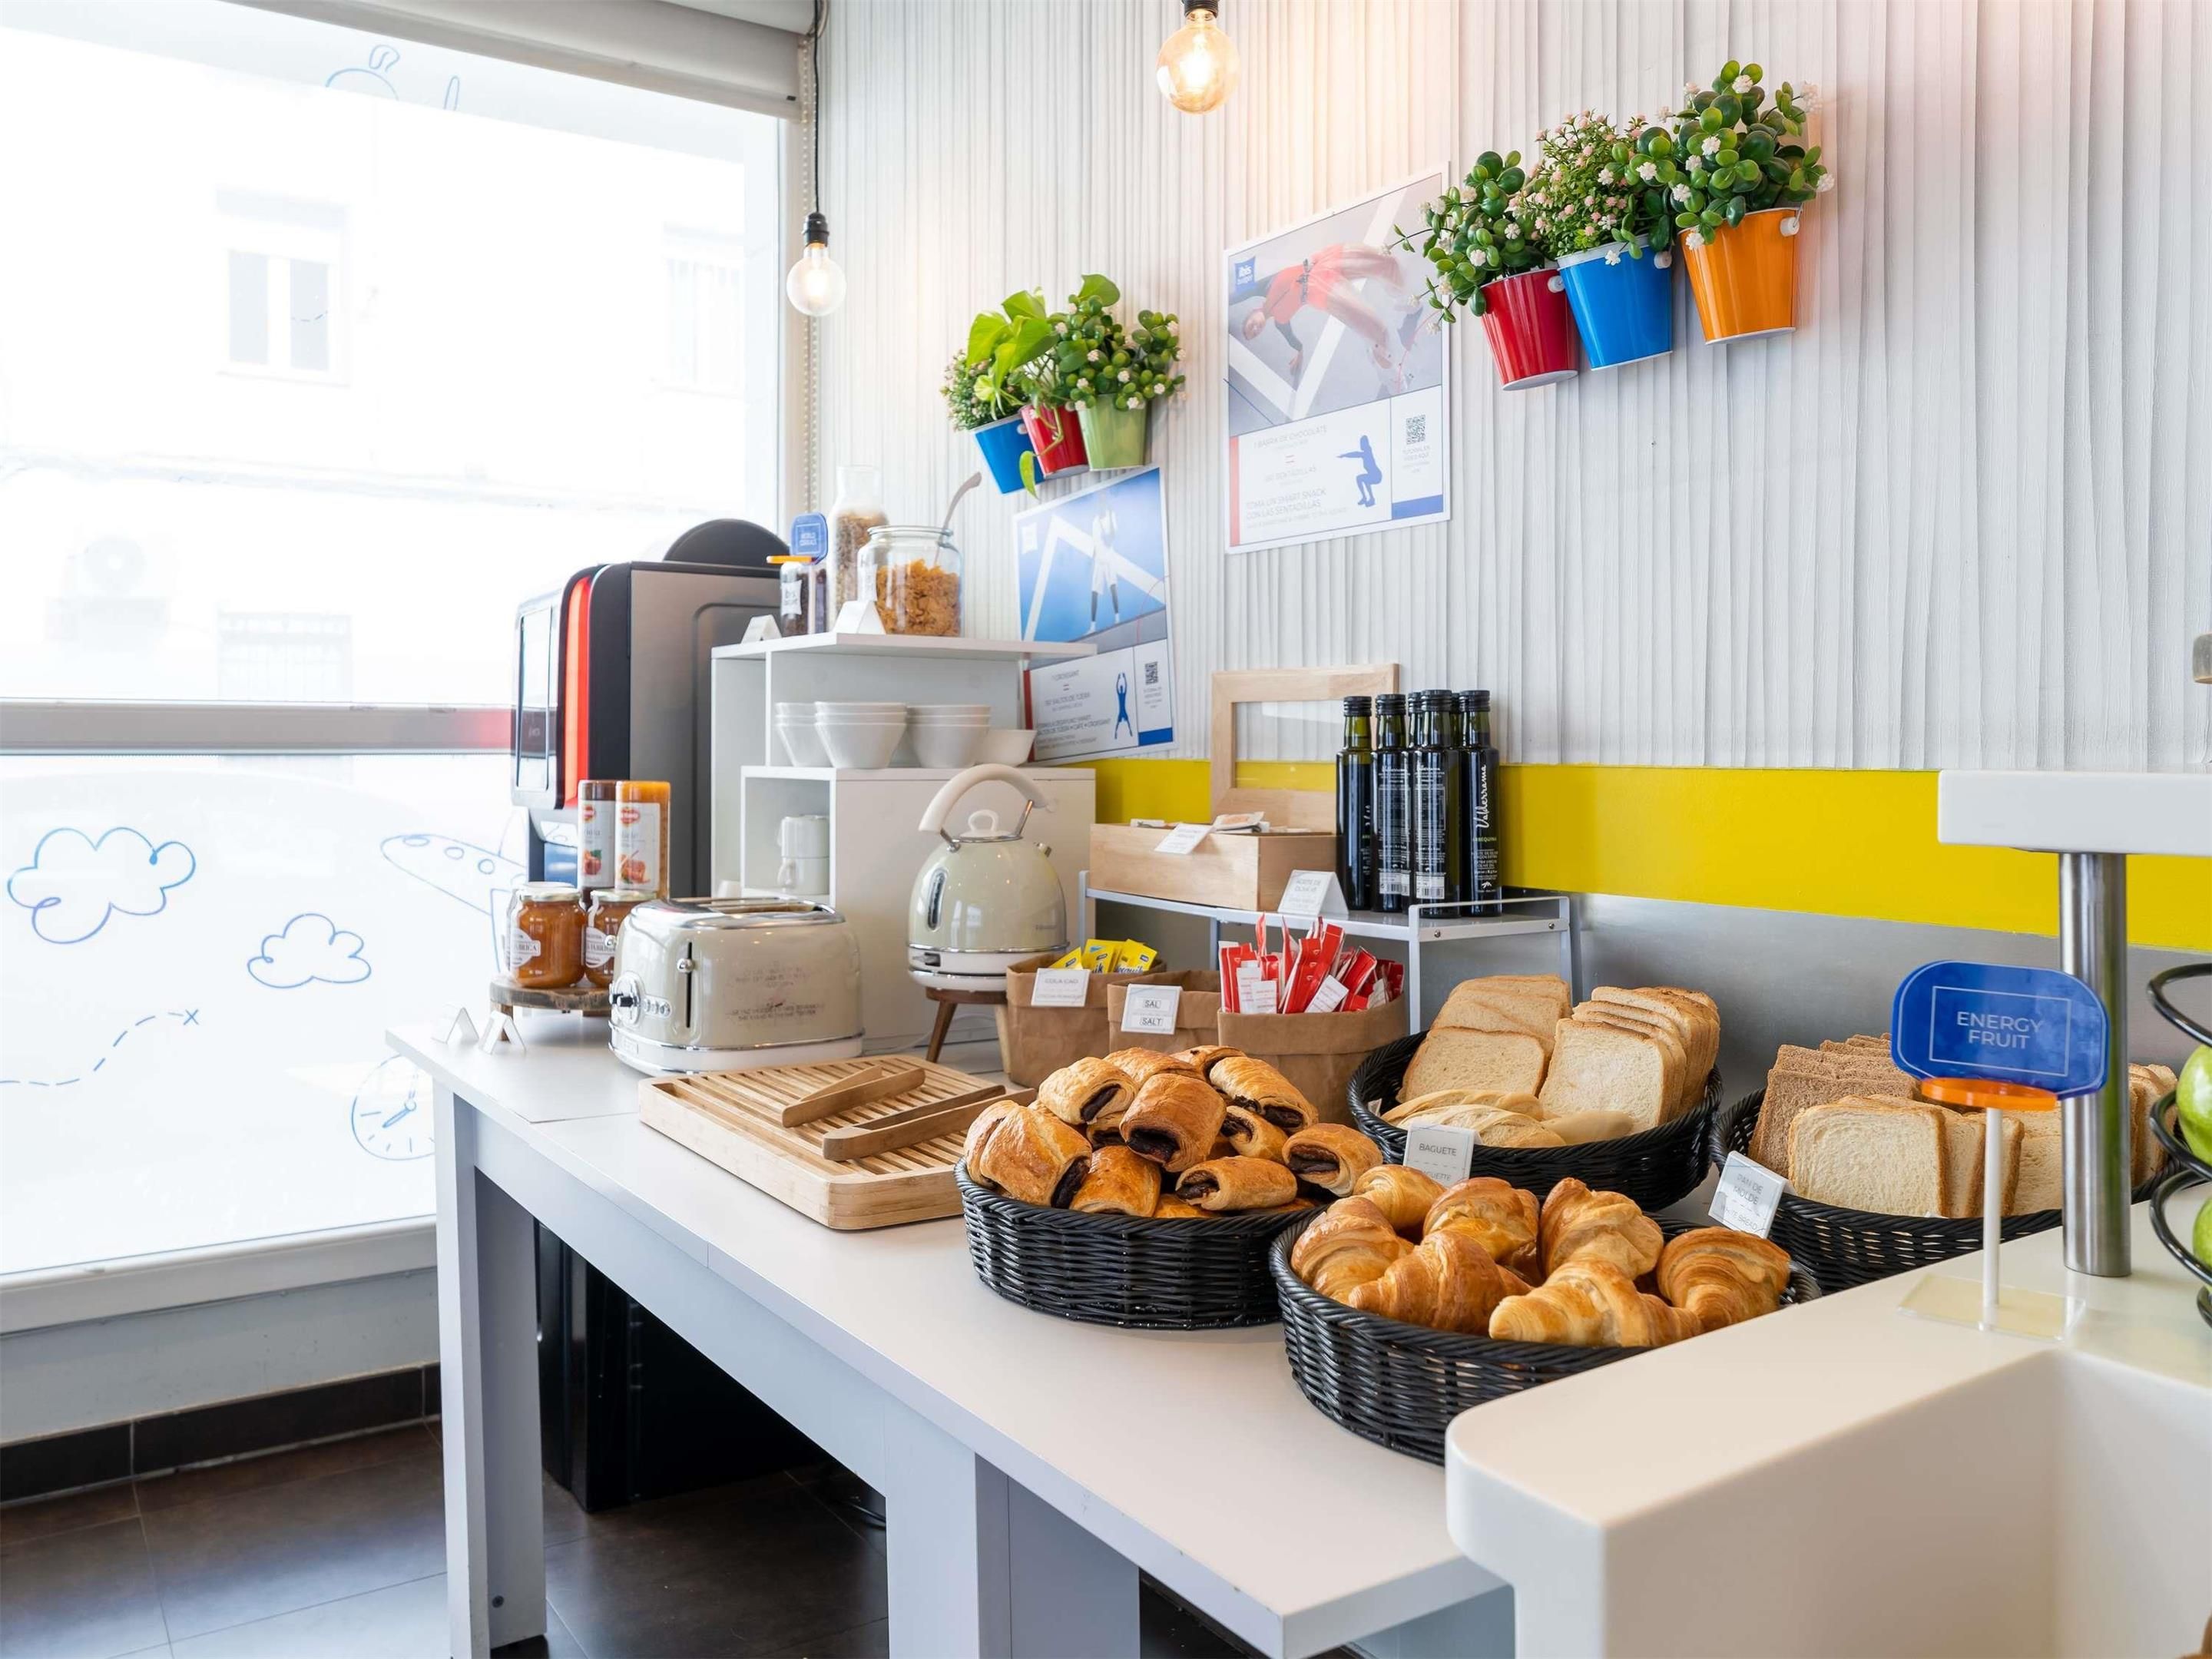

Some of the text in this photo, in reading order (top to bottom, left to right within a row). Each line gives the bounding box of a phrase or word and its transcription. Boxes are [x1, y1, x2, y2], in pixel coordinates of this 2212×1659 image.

[1290, 424, 1327, 440] CHOCOLATE
[1302, 487, 1326, 498] SNACK
[1275, 498, 1322, 514] SENTADILLAS
[1473, 764, 1490, 830] Valderrama
[1144, 1000, 1161, 1008] SAL
[1141, 1018, 1162, 1026] SALT
[1957, 1011, 2043, 1033] ENERGY
[1969, 1029, 2031, 1049] FRUIT
[1419, 1143, 1457, 1157] BAGUETE
[1737, 1174, 1764, 1196] PAN DE
[1732, 1185, 1760, 1206] MOLDE
